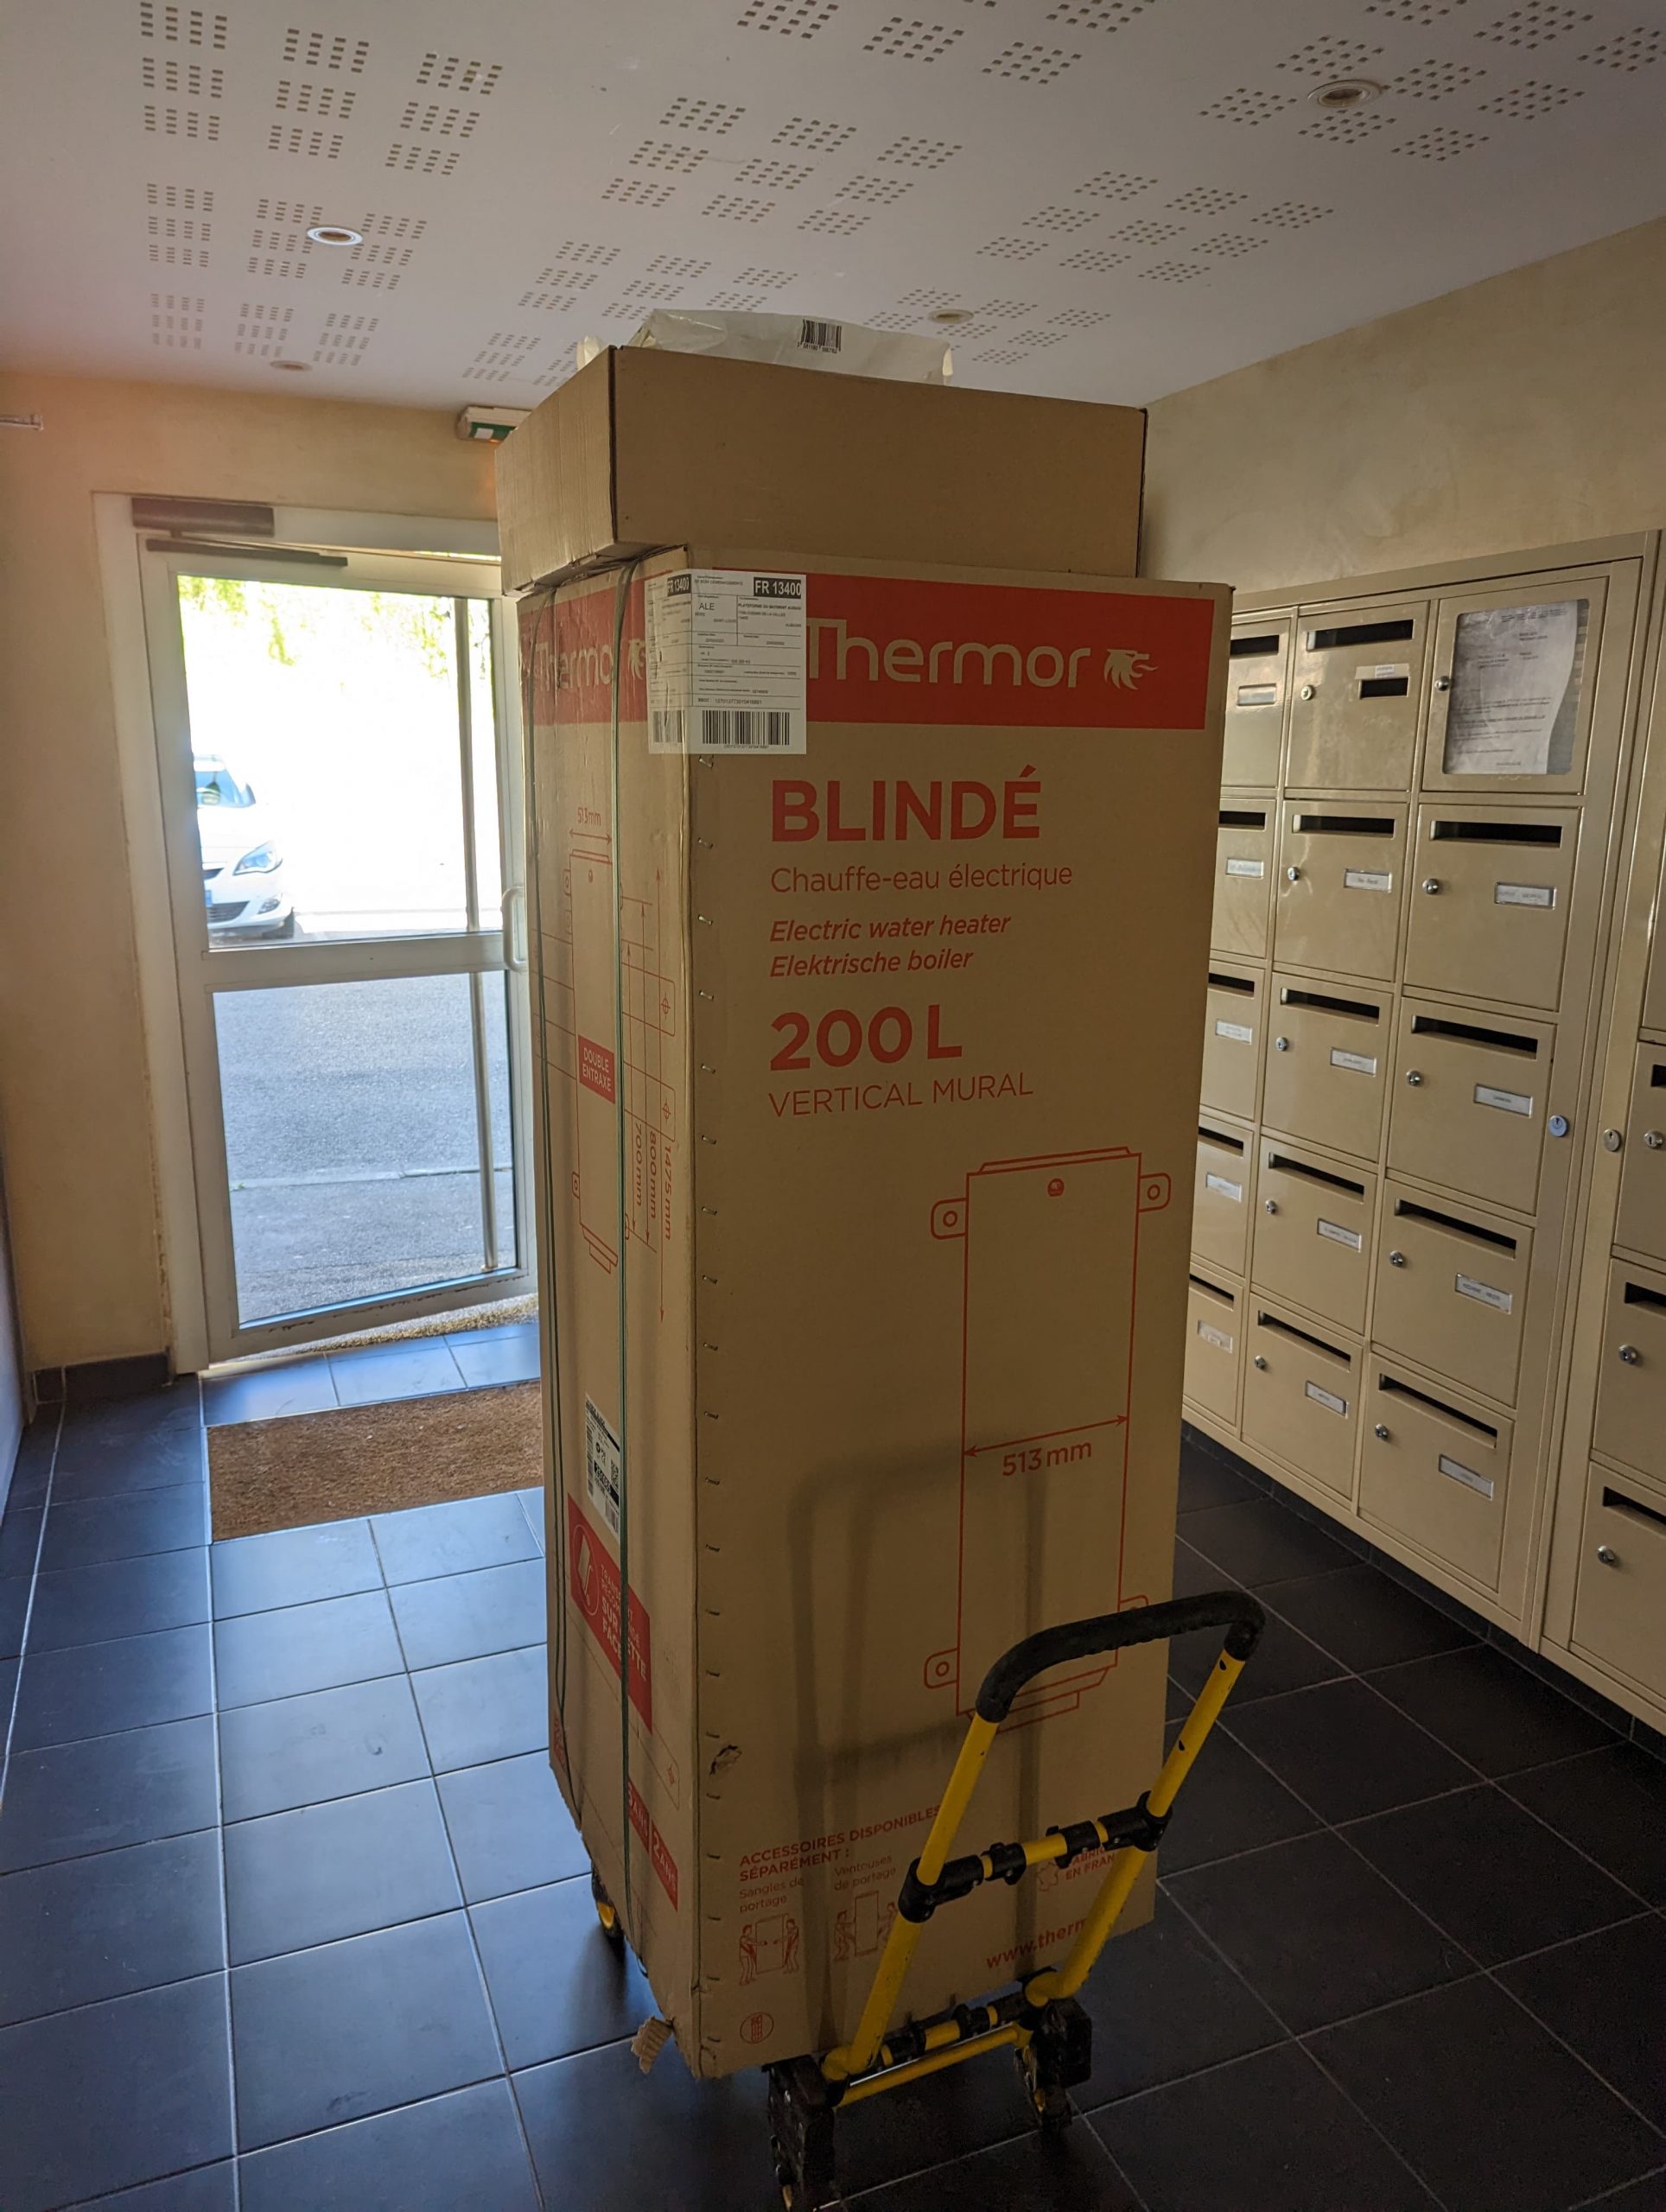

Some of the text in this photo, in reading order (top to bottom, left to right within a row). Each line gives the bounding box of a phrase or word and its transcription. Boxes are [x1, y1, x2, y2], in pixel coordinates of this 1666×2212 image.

[755, 580, 770, 594] FR
[773, 582, 802, 596] 13400
[535, 641, 614, 692] Thermo
[806, 616, 1091, 689] Thermor
[772, 764, 1041, 842] BLINDÉ
[771, 862, 1072, 893] Chauffe-eau électrique
[770, 913, 1011, 943] Electric water heater
[770, 949, 974, 977] Elektrische boiler
[583, 1047, 609, 1073] DOUBLE
[582, 1064, 612, 1092] ENTRAXE
[769, 1071, 1033, 1117] VERTICAL MURAL
[602, 1596, 618, 1633] SUR
[740, 1805, 942, 1867] ACCESSOIRES DISPONIBLES
[739, 1848, 842, 1883] SÉPARÉMENT
[834, 1855, 893, 1877] Ventouses
[834, 1866, 897, 1891] de portage
[1065, 1852, 1115, 1881] EN FRAN
[739, 1877, 804, 1899] Sangles de
[739, 1893, 787, 1914] portage
